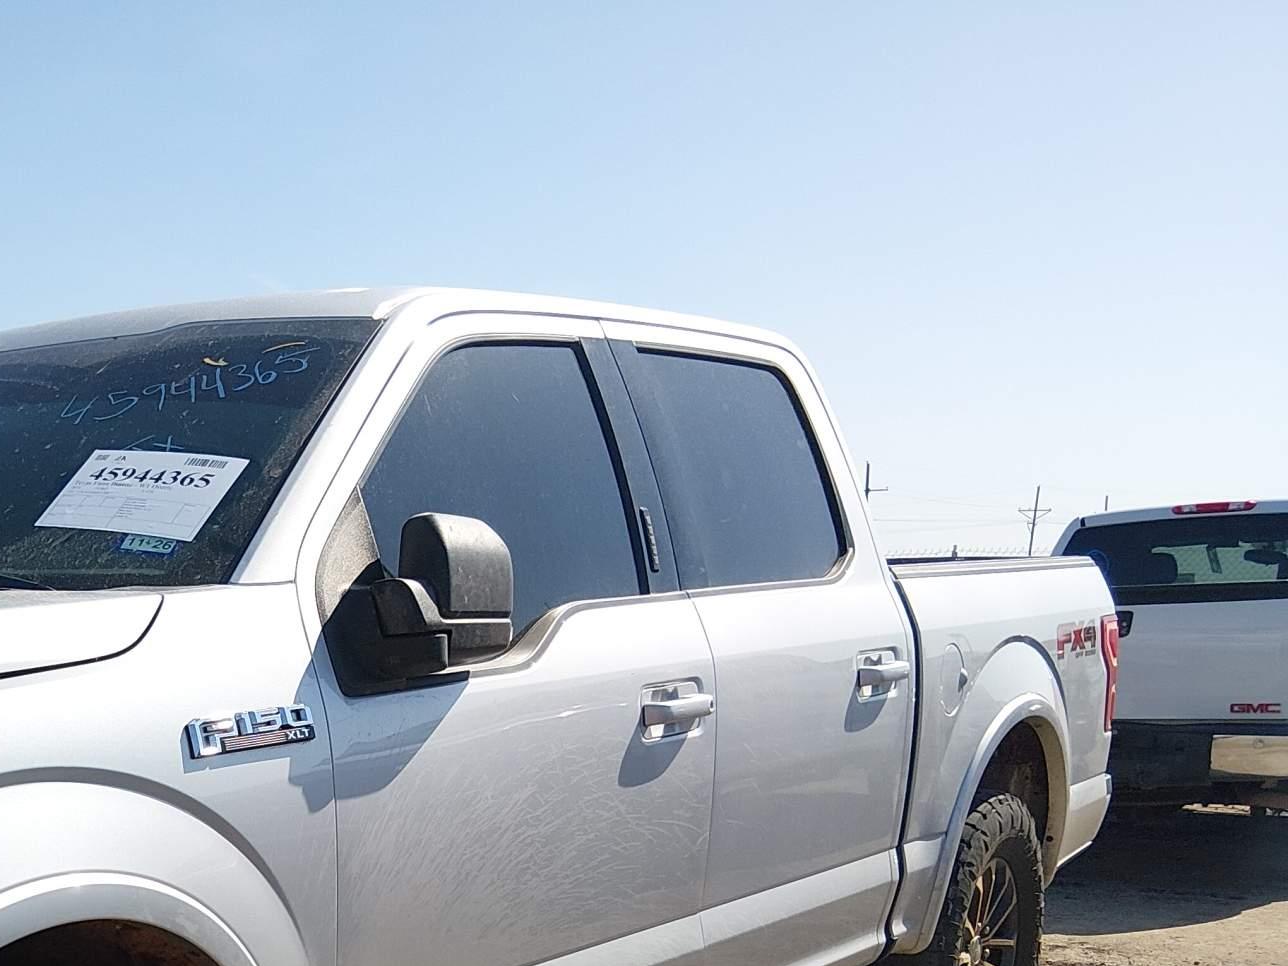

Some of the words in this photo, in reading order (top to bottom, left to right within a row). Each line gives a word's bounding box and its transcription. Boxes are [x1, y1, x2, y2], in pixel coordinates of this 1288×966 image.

[61, 347, 320, 425] 45944365
[89, 466, 215, 489] 45944365
[152, 539, 174, 550] 26
[1056, 619, 1097, 660] FX4
[1230, 703, 1281, 714] GMC
[287, 728, 311, 740] XLT
